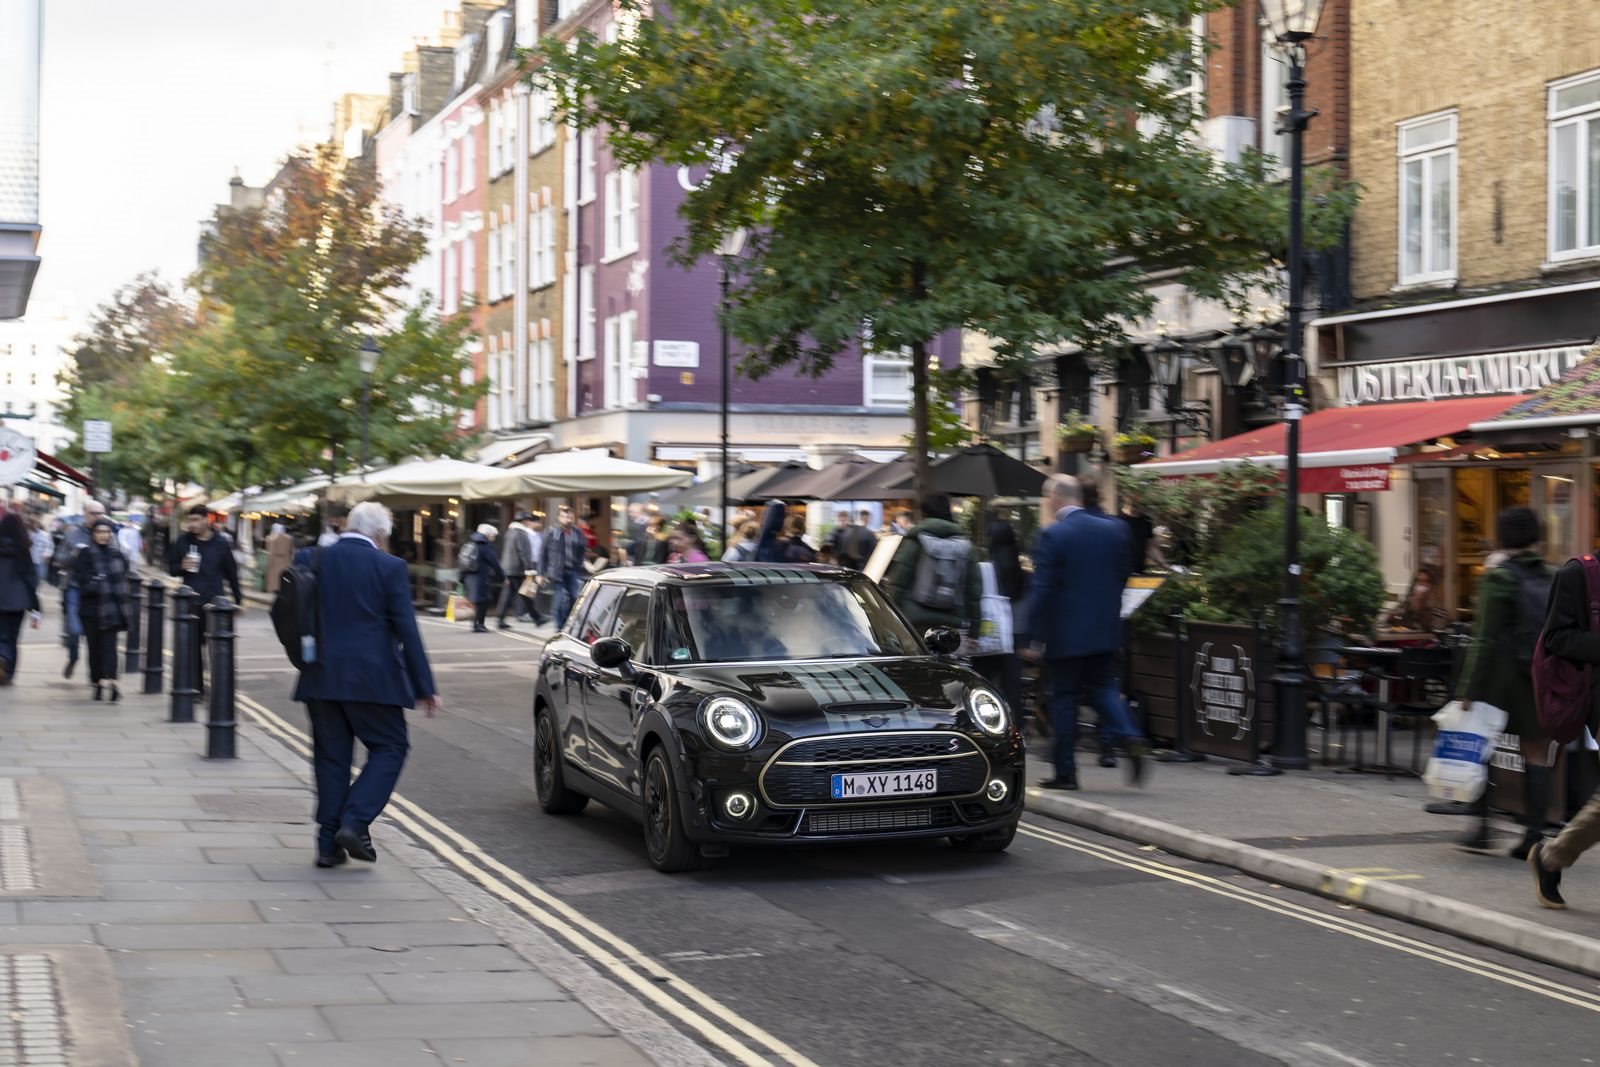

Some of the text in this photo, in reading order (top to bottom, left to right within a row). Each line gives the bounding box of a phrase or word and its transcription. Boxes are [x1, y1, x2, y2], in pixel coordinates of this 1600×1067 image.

[843, 777, 855, 795] M
[866, 775, 889, 794] XY
[893, 773, 935, 792] 1148
